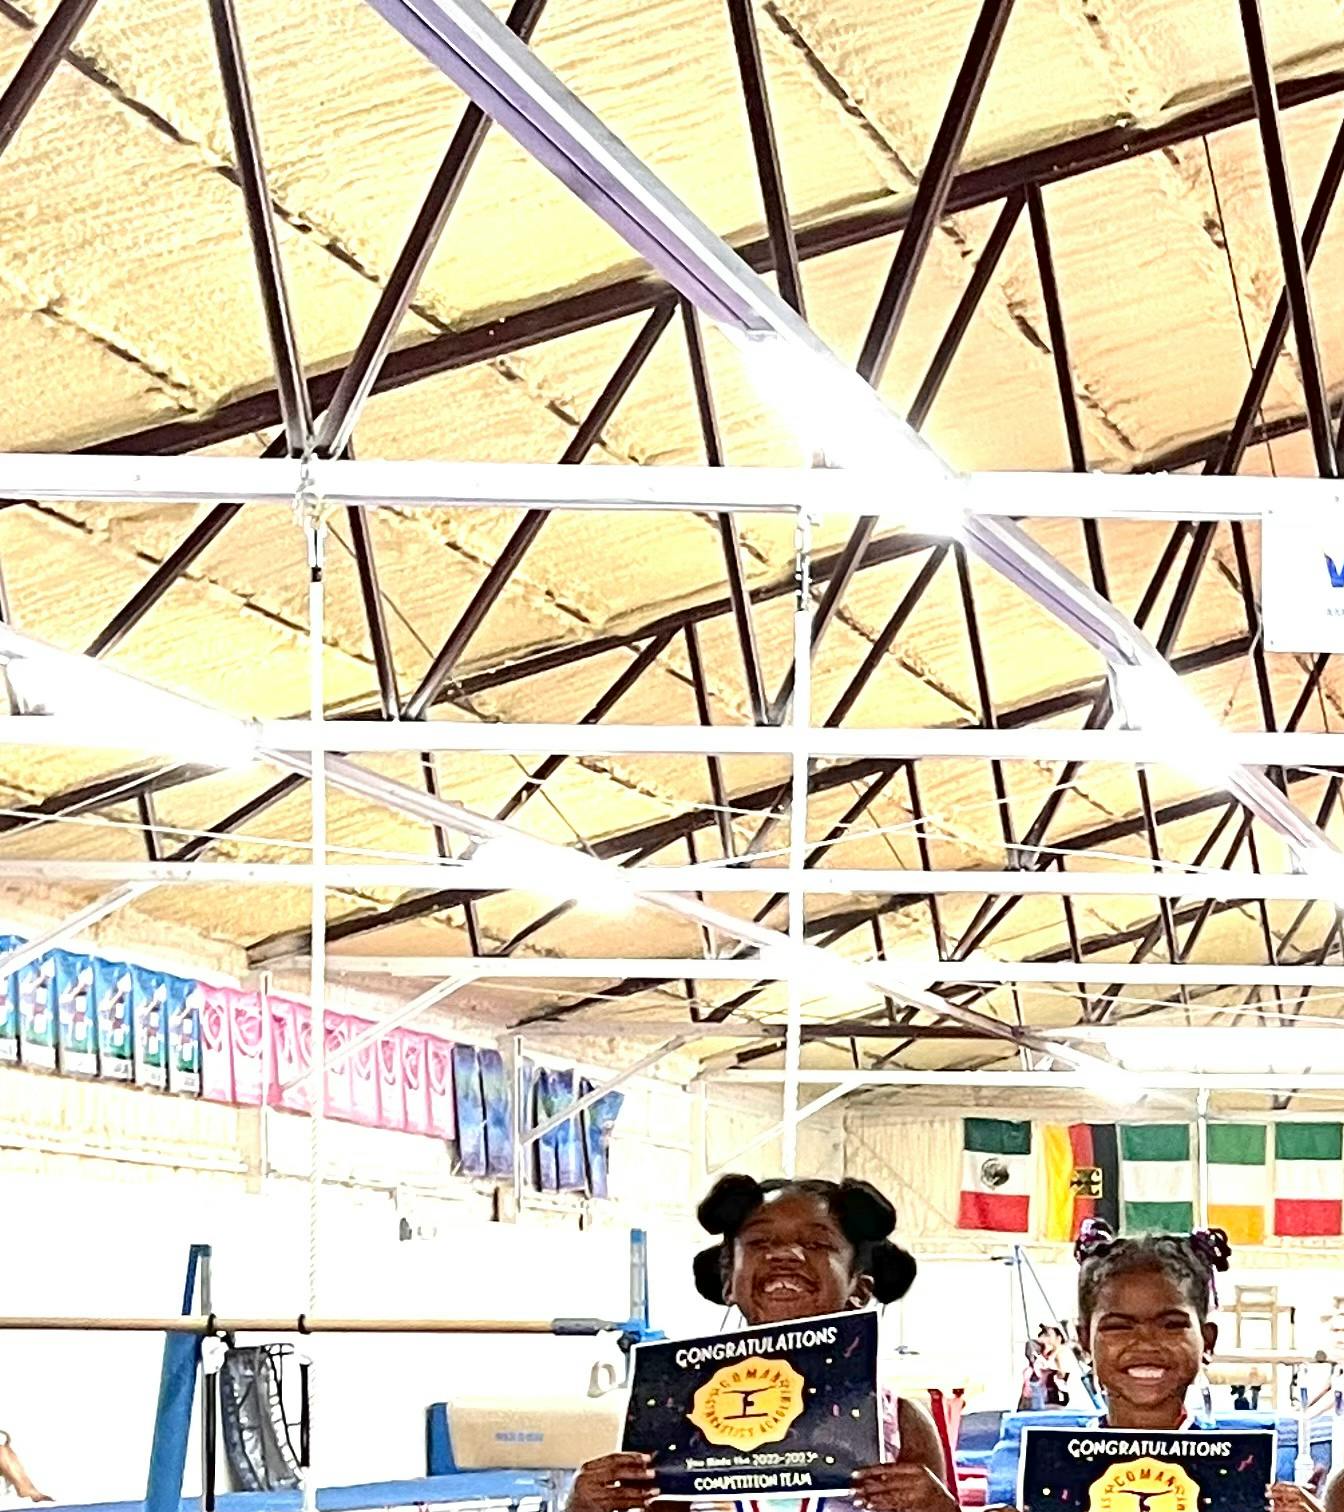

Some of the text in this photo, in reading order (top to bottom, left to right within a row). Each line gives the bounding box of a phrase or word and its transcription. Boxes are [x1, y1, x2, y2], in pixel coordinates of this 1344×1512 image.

[675, 1327, 838, 1367] CONGRATULATIONS
[1068, 1438, 1232, 1459] CONGRATULATIONS
[694, 1472, 812, 1490] COMPETITION TEAM
